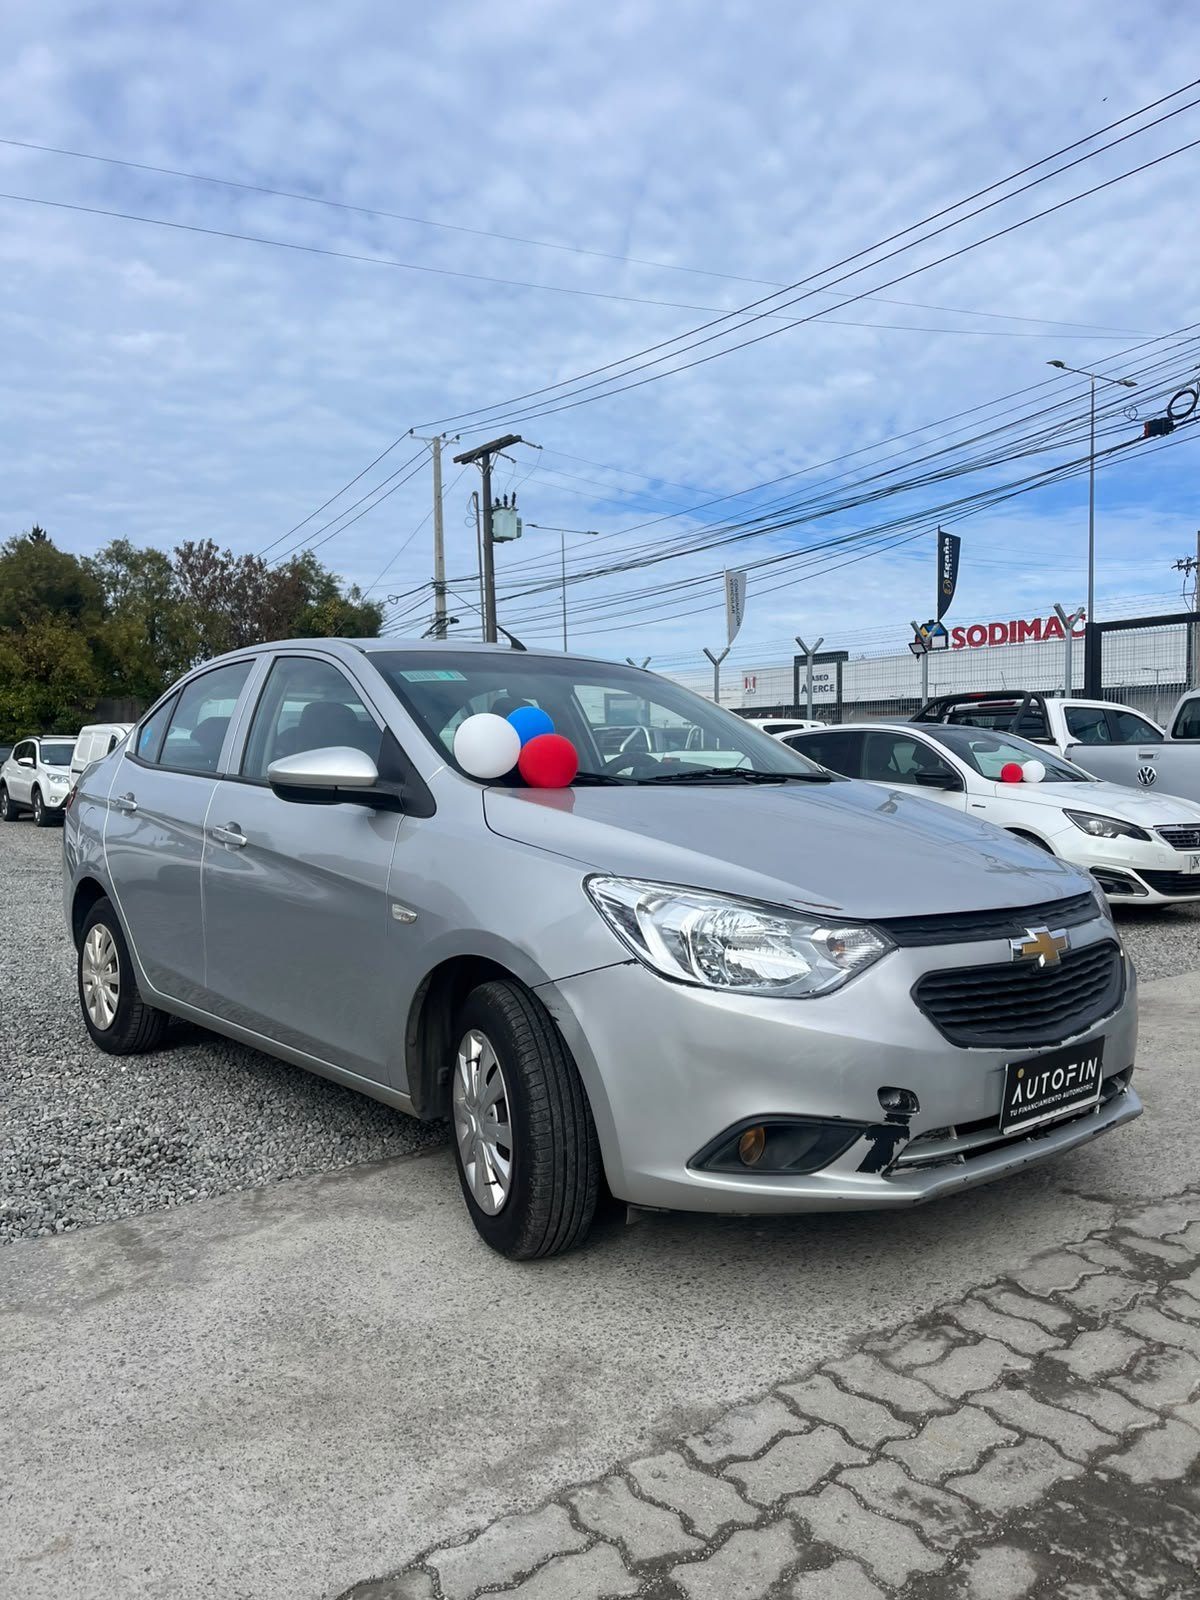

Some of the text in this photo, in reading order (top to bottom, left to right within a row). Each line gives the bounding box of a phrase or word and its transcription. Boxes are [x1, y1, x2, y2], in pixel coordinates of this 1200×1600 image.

[951, 613, 1086, 649] SODIMAC
[801, 684, 835, 694] AERCE
[806, 674, 829, 682] ASEO
[1011, 1057, 1098, 1105] AUTOFIN
[1018, 1093, 1062, 1115] FINANCIAMIENTO
[1062, 1082, 1094, 1099] AUTOMOTRIZ
